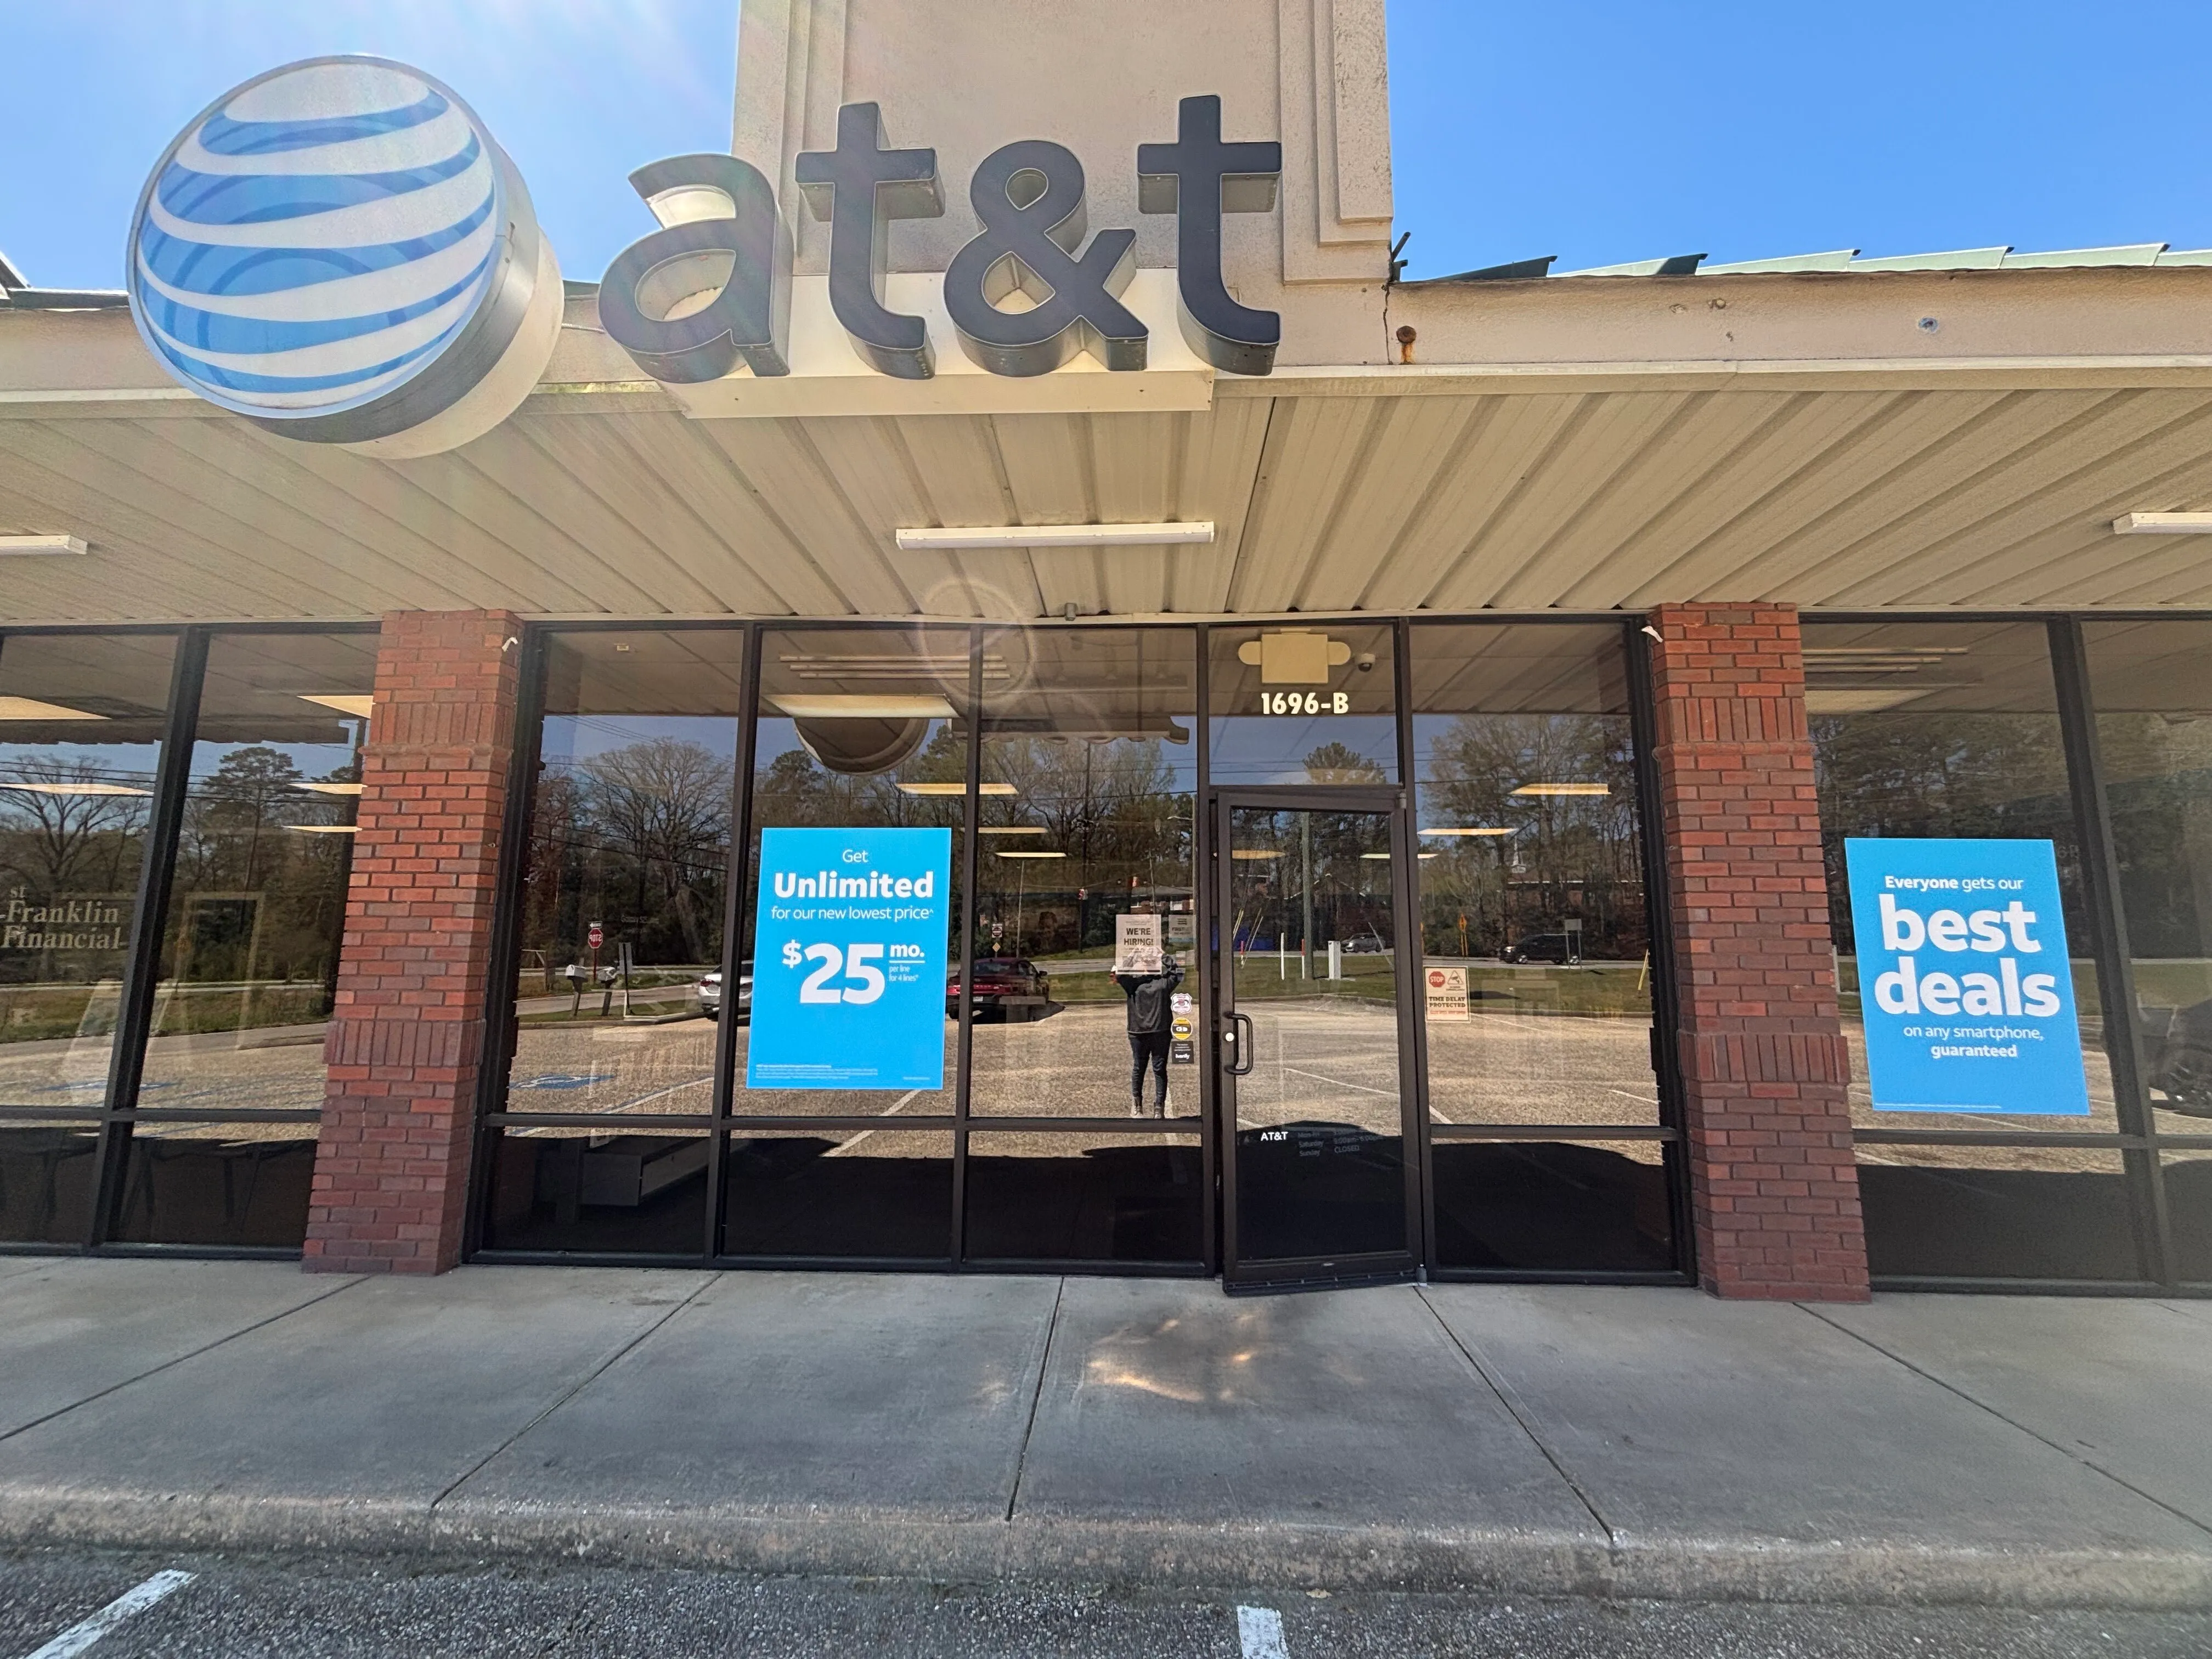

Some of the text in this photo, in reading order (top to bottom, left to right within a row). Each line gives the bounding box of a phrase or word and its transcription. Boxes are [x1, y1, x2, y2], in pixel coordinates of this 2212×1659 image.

[597, 94, 1282, 381] at&t
[1261, 692, 1349, 714] 1696-B
[842, 849, 868, 863] Get
[774, 871, 934, 898] Unlimited
[1884, 876, 2024, 892] Everyone gets our
[7, 900, 119, 923] Franklin
[771, 906, 791, 919] for
[793, 908, 815, 919] our
[819, 908, 846, 919] new
[849, 906, 891, 919] lowest
[1878, 894, 2042, 953] best
[1, 924, 121, 949] Financial
[890, 944, 925, 957] mo.
[1875, 956, 2061, 1017] deals
[1904, 1027, 1921, 1037] on
[1925, 1028, 1950, 1040] any
[1930, 1045, 2018, 1059] guaranteed
[1261, 1131, 1289, 1141] AT&T
[1334, 1145, 1359, 1153] CLOSED
